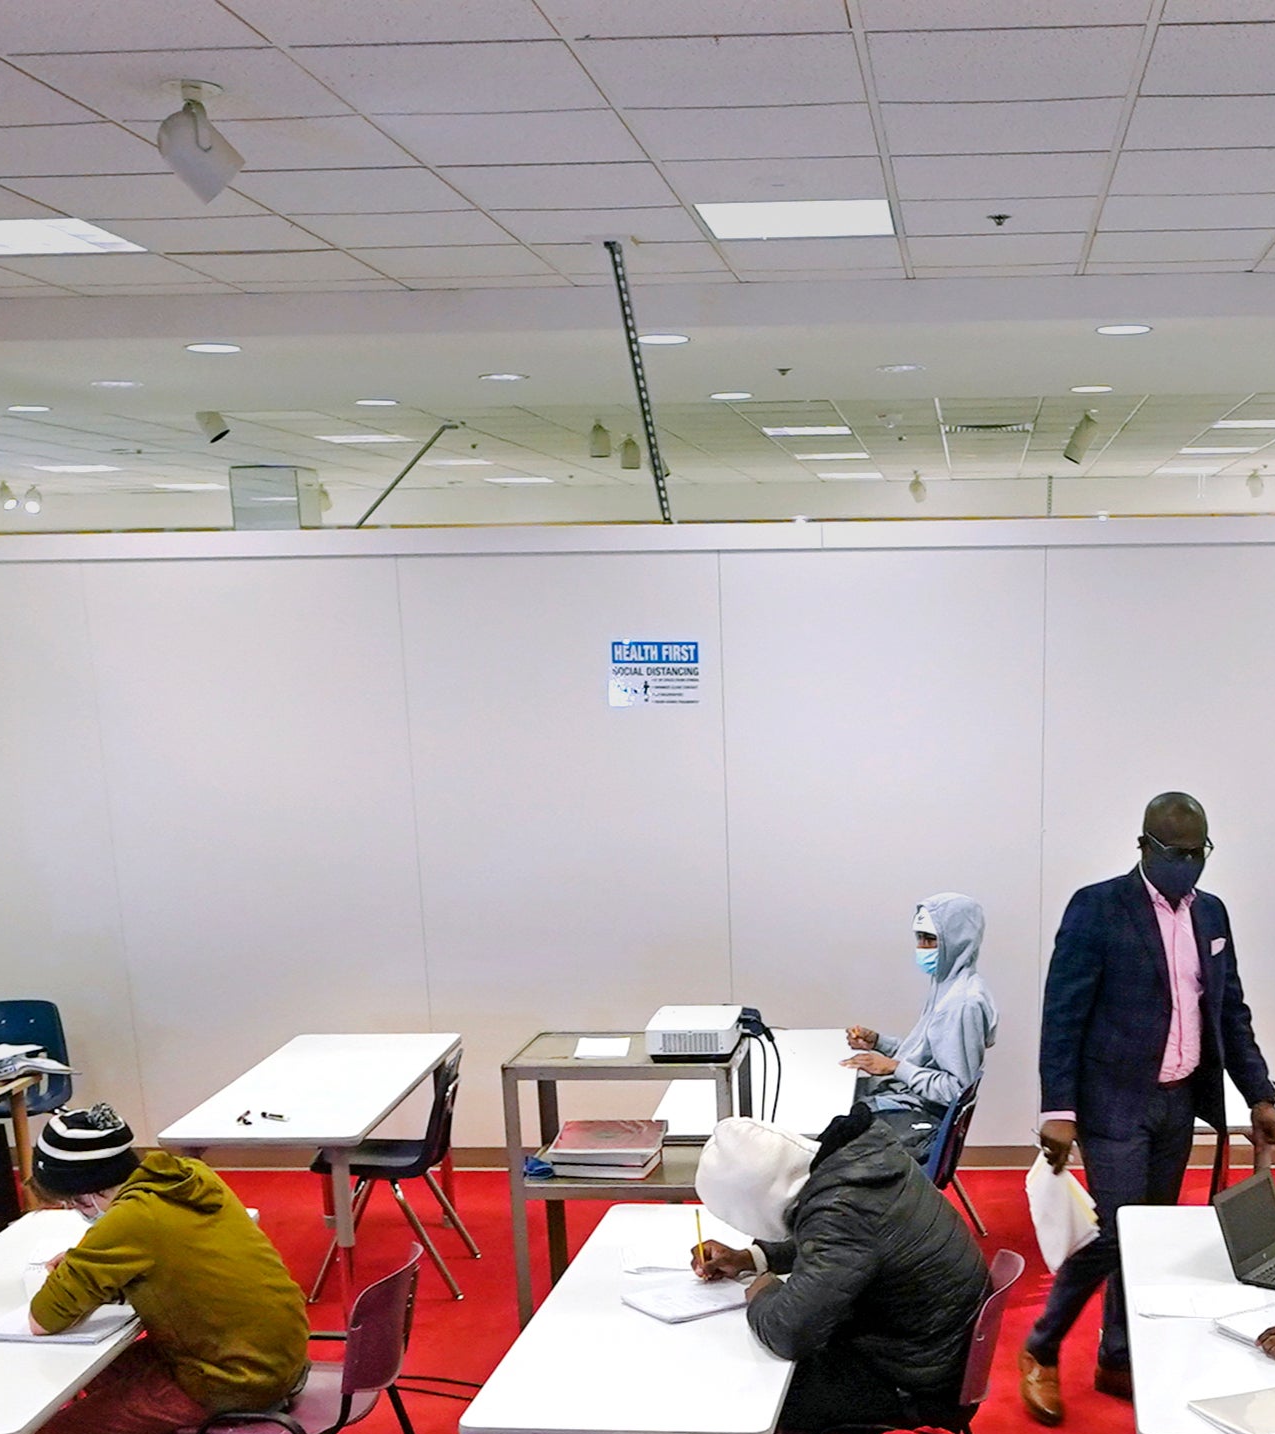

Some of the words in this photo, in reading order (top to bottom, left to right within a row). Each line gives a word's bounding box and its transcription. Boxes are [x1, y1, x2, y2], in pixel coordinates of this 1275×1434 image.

[614, 644, 658, 661] HEALTH
[662, 644, 696, 661] FIRST
[646, 666, 699, 677] DISTANCING
